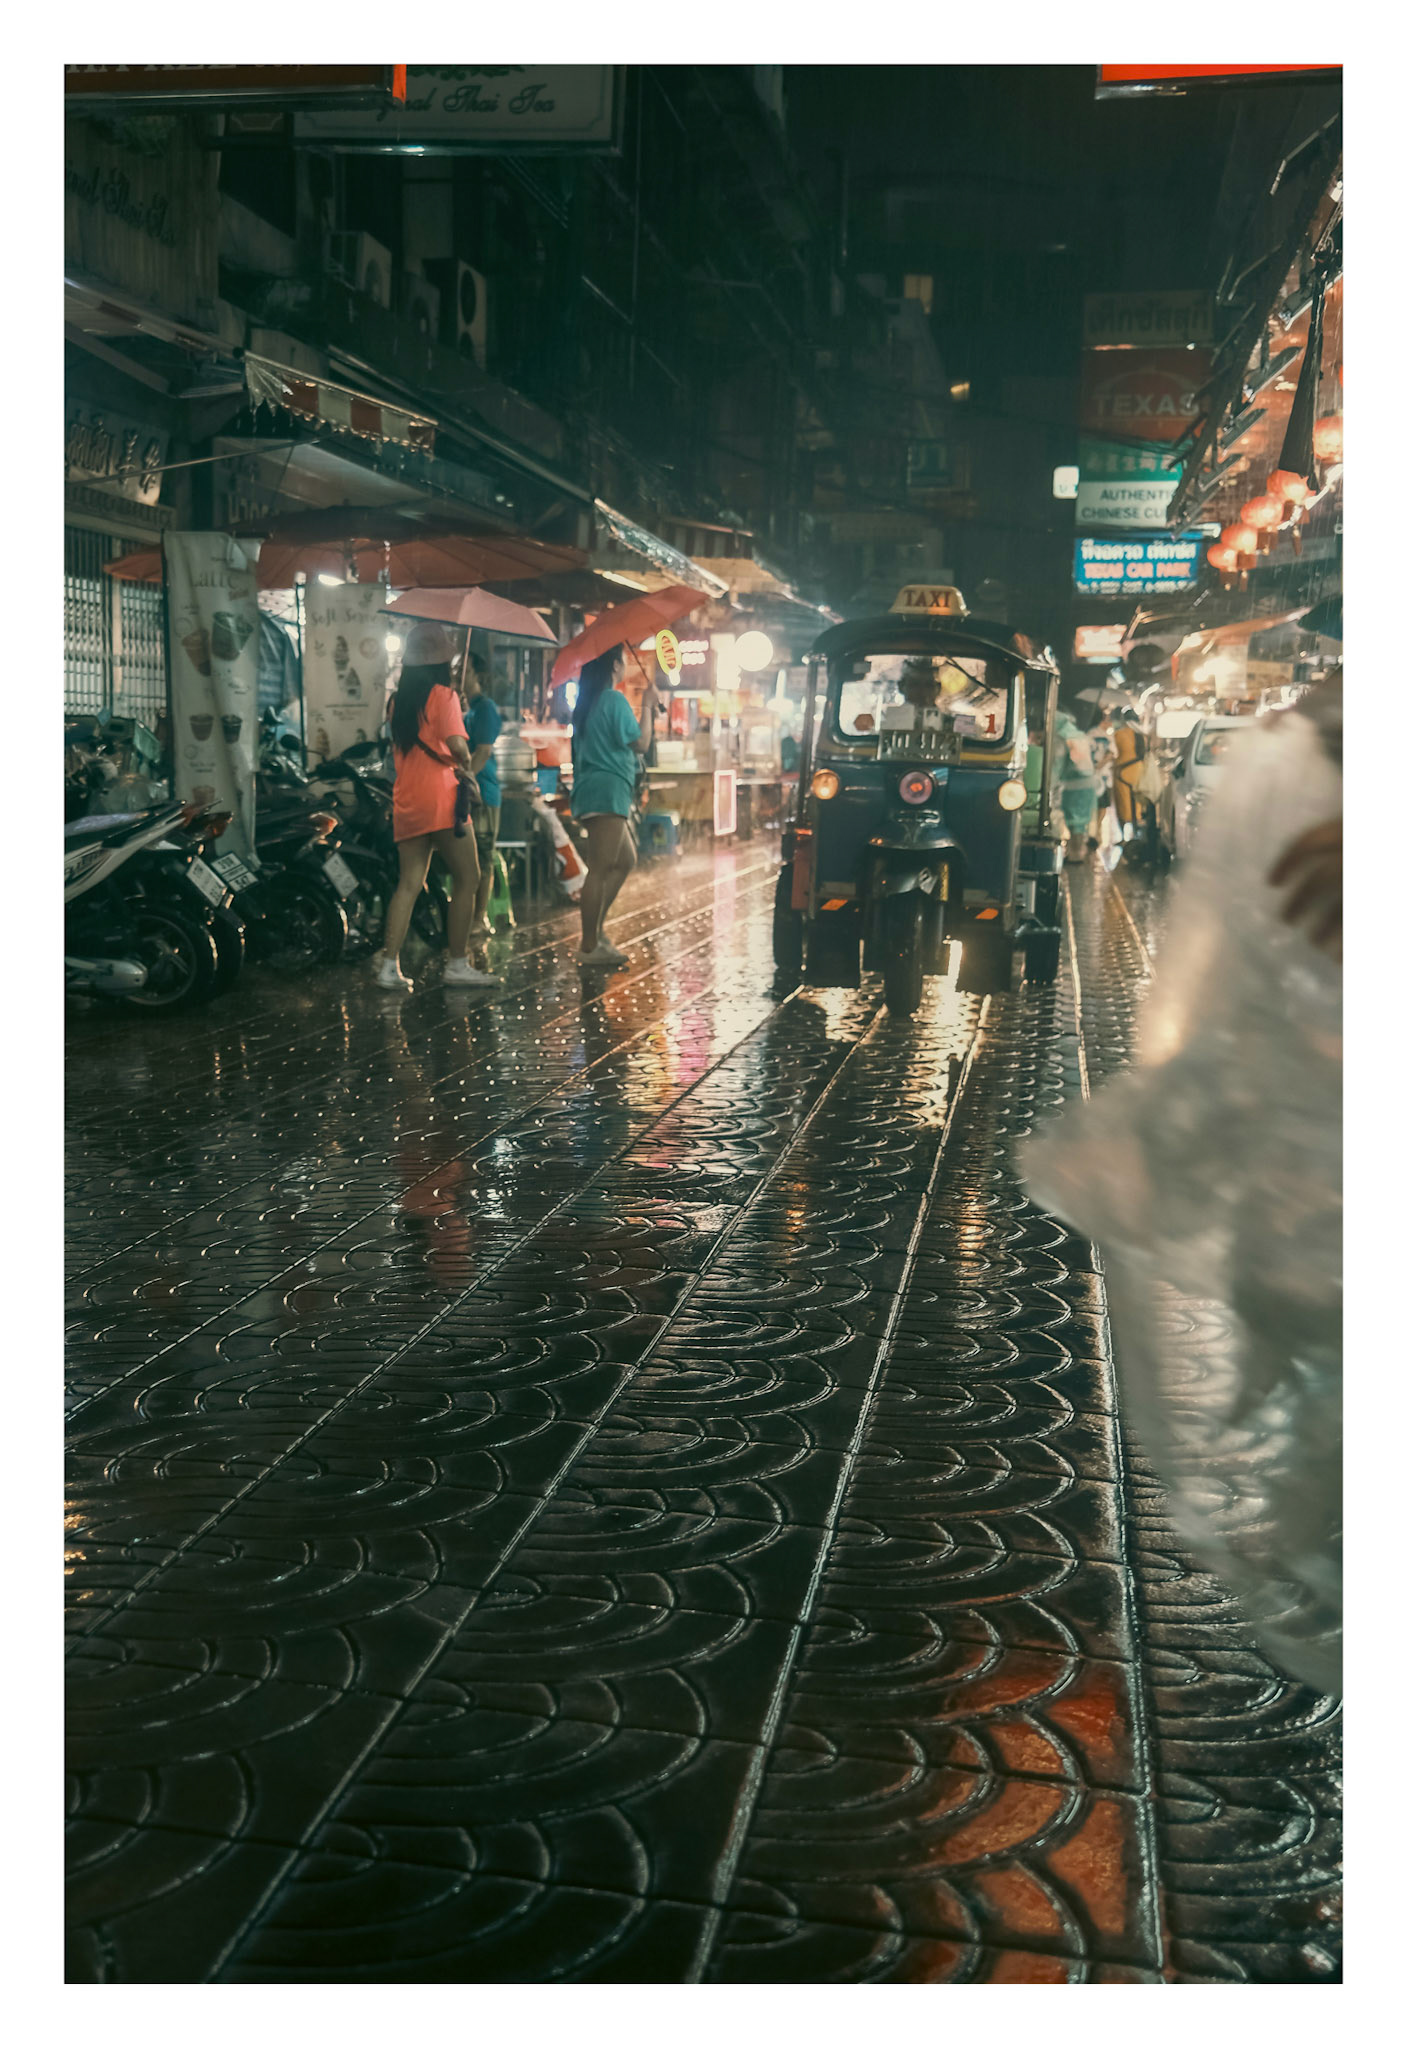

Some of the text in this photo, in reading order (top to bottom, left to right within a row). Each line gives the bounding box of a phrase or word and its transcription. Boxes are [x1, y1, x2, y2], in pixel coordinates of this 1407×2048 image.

[443, 84, 501, 113] Thai
[508, 83, 556, 115] Tea
[1089, 393, 1200, 417] TEXAS
[1081, 507, 1139, 520] CHINESE
[1084, 562, 1190, 578] TEXAS CAR PARK
[904, 590, 951, 608] TAXI
[984, 713, 997, 734] 1
